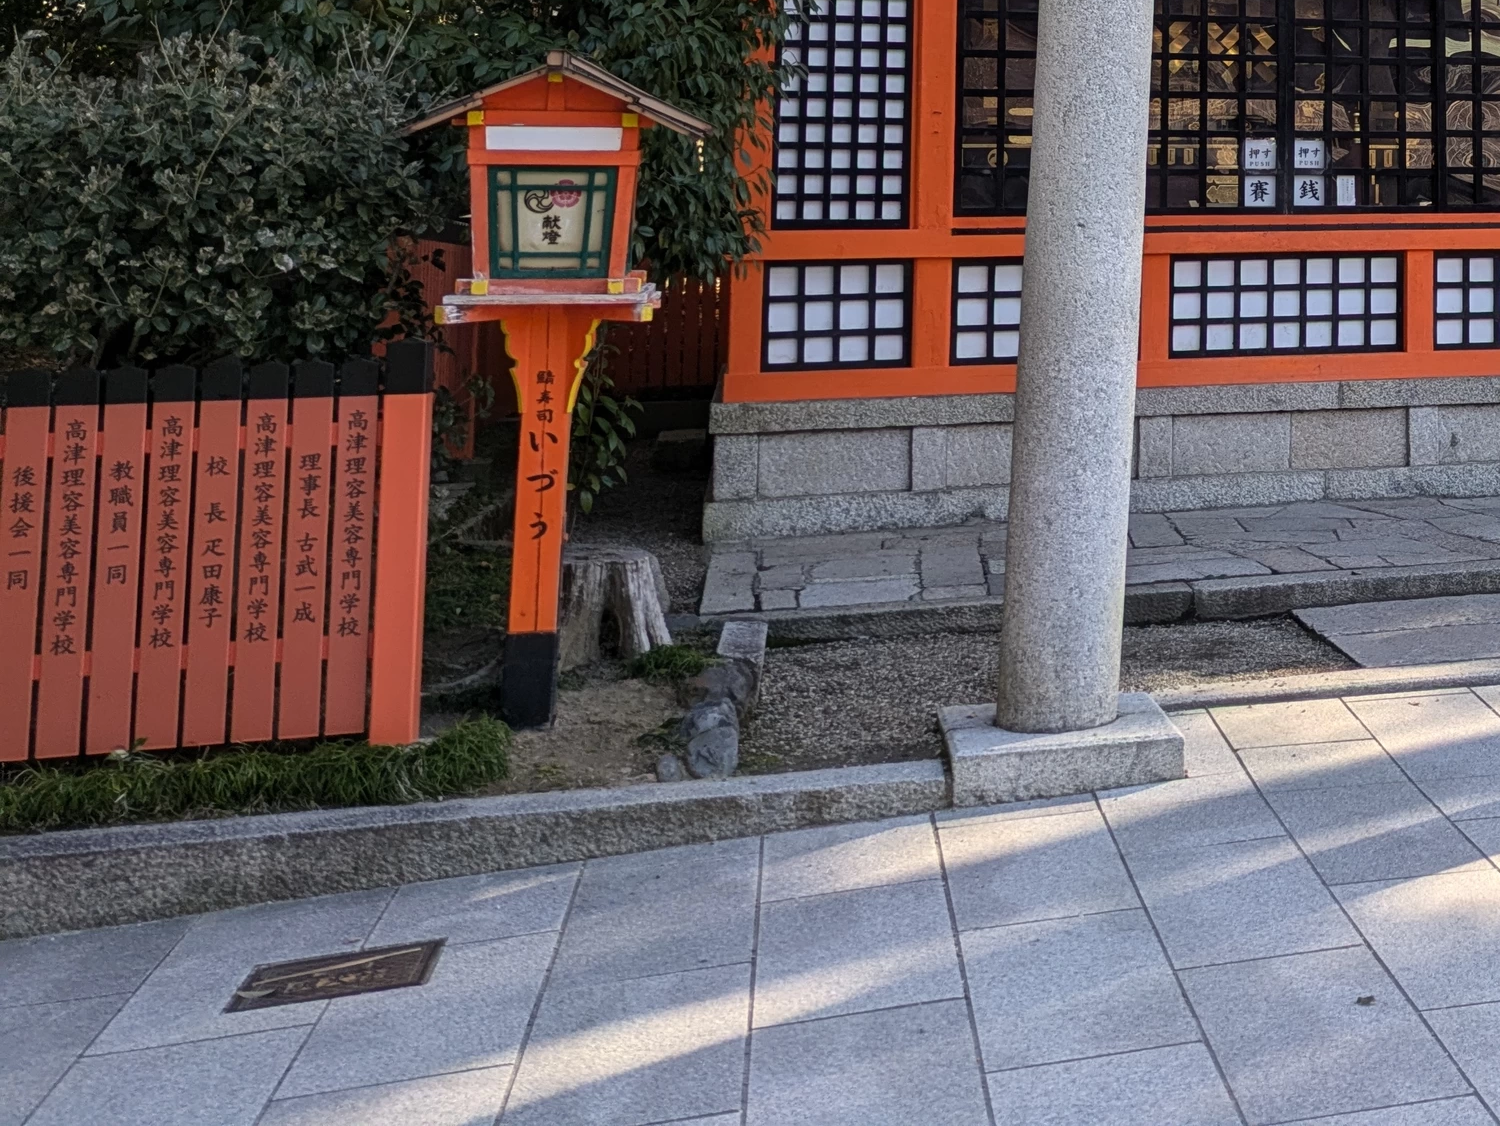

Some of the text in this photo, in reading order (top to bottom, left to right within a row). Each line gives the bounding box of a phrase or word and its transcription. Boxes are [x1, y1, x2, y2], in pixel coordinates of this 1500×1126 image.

[1248, 147, 1272, 159] 押す
[1250, 180, 1270, 203] 賽
[1299, 180, 1320, 201] 銭
[1298, 146, 1321, 159] 押す
[541, 215, 562, 245] 献燈
[7, 466, 37, 591] 後援会一同
[50, 419, 88, 656] 高津理容美容専門学校
[106, 460, 135, 585] 教職員一同
[149, 415, 184, 649] 高津理容美容専門学校
[244, 412, 278, 643] 高津理容美容専門学校
[292, 452, 323, 623] 理事長 古武一成
[337, 409, 369, 637] 高津理容美容専門学校
[525, 431, 558, 541] いづう
